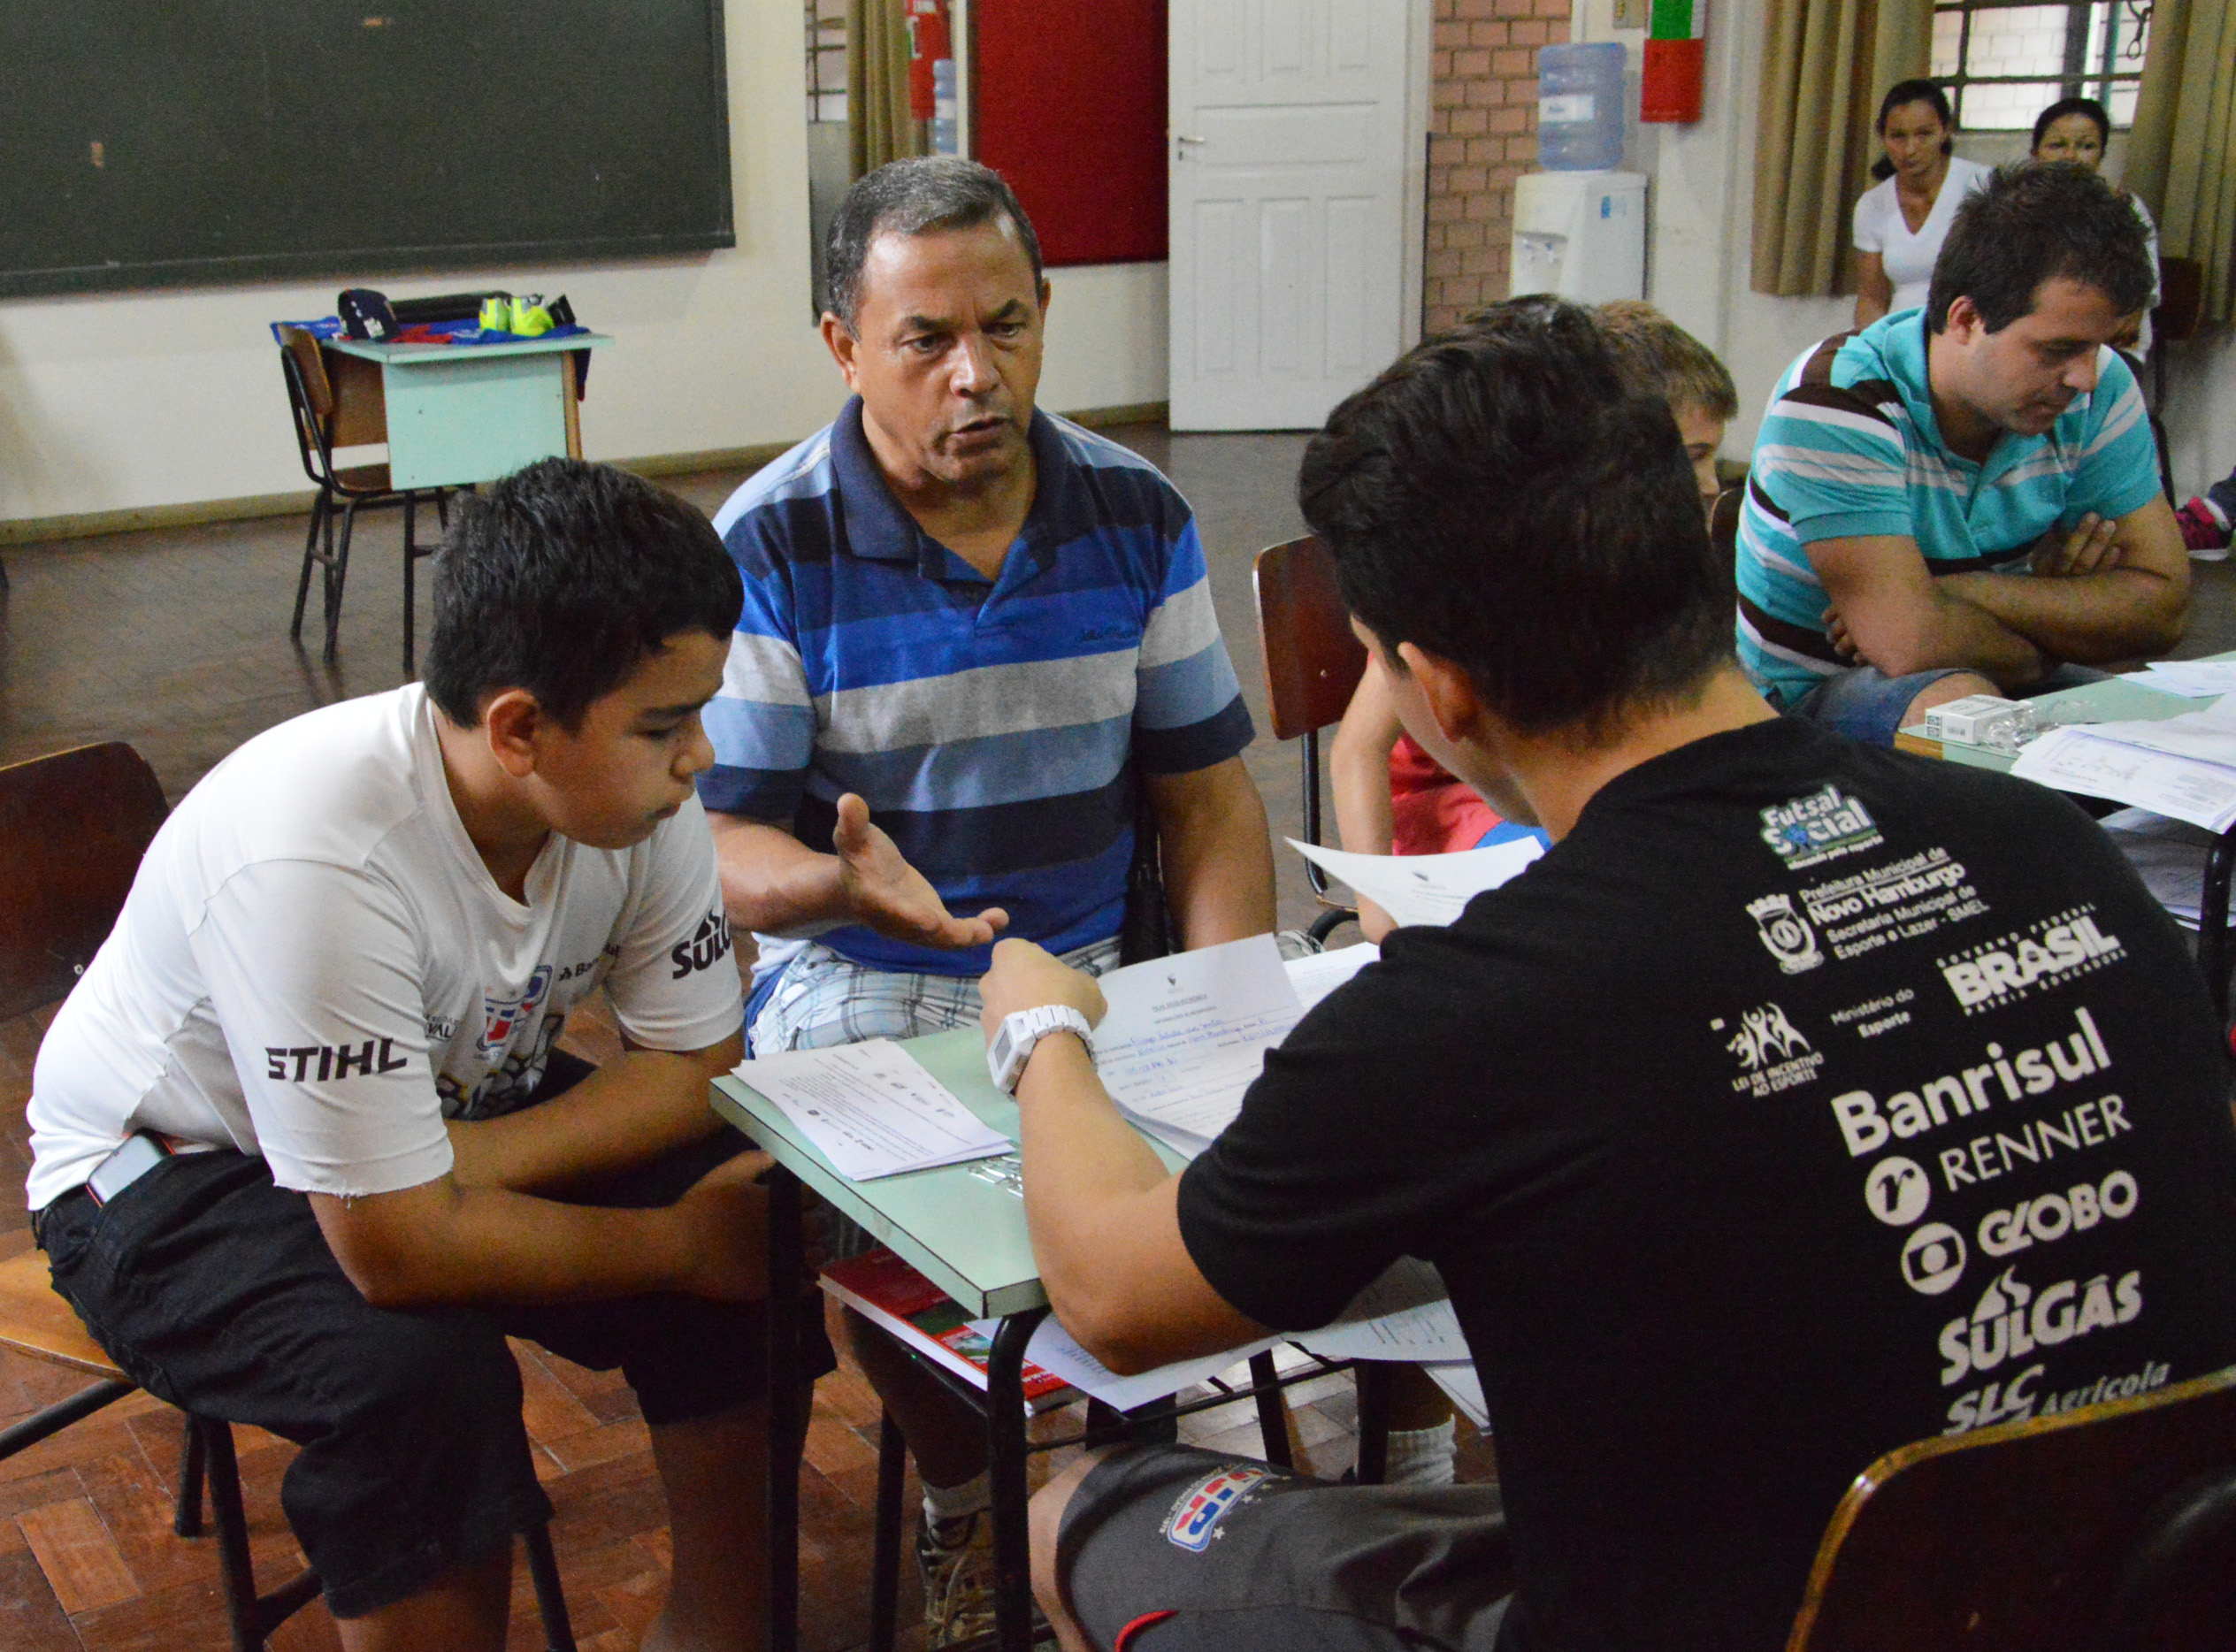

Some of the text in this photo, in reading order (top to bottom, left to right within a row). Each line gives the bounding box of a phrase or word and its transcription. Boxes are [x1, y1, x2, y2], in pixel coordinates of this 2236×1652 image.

[1763, 786, 1841, 827] Futsal
[1799, 846, 1948, 902] Prefeitura Municipal de
[1807, 862, 1966, 926] Novo Hamburgo
[1826, 885, 1977, 943] Secretaria Municipal de
[1834, 933, 1887, 960] Esporte
[1943, 915, 2121, 1007] BRASIL
[1857, 1011, 1911, 1038] Esporte
[1895, 988, 1914, 1003] do
[264, 1037, 408, 1082] STIHL
[1831, 1006, 2112, 1157] Banrisul
[1940, 1093, 2133, 1192] RENNER
[1978, 1169, 2139, 1258] GLOBO
[1941, 1363, 2046, 1436] SLC
